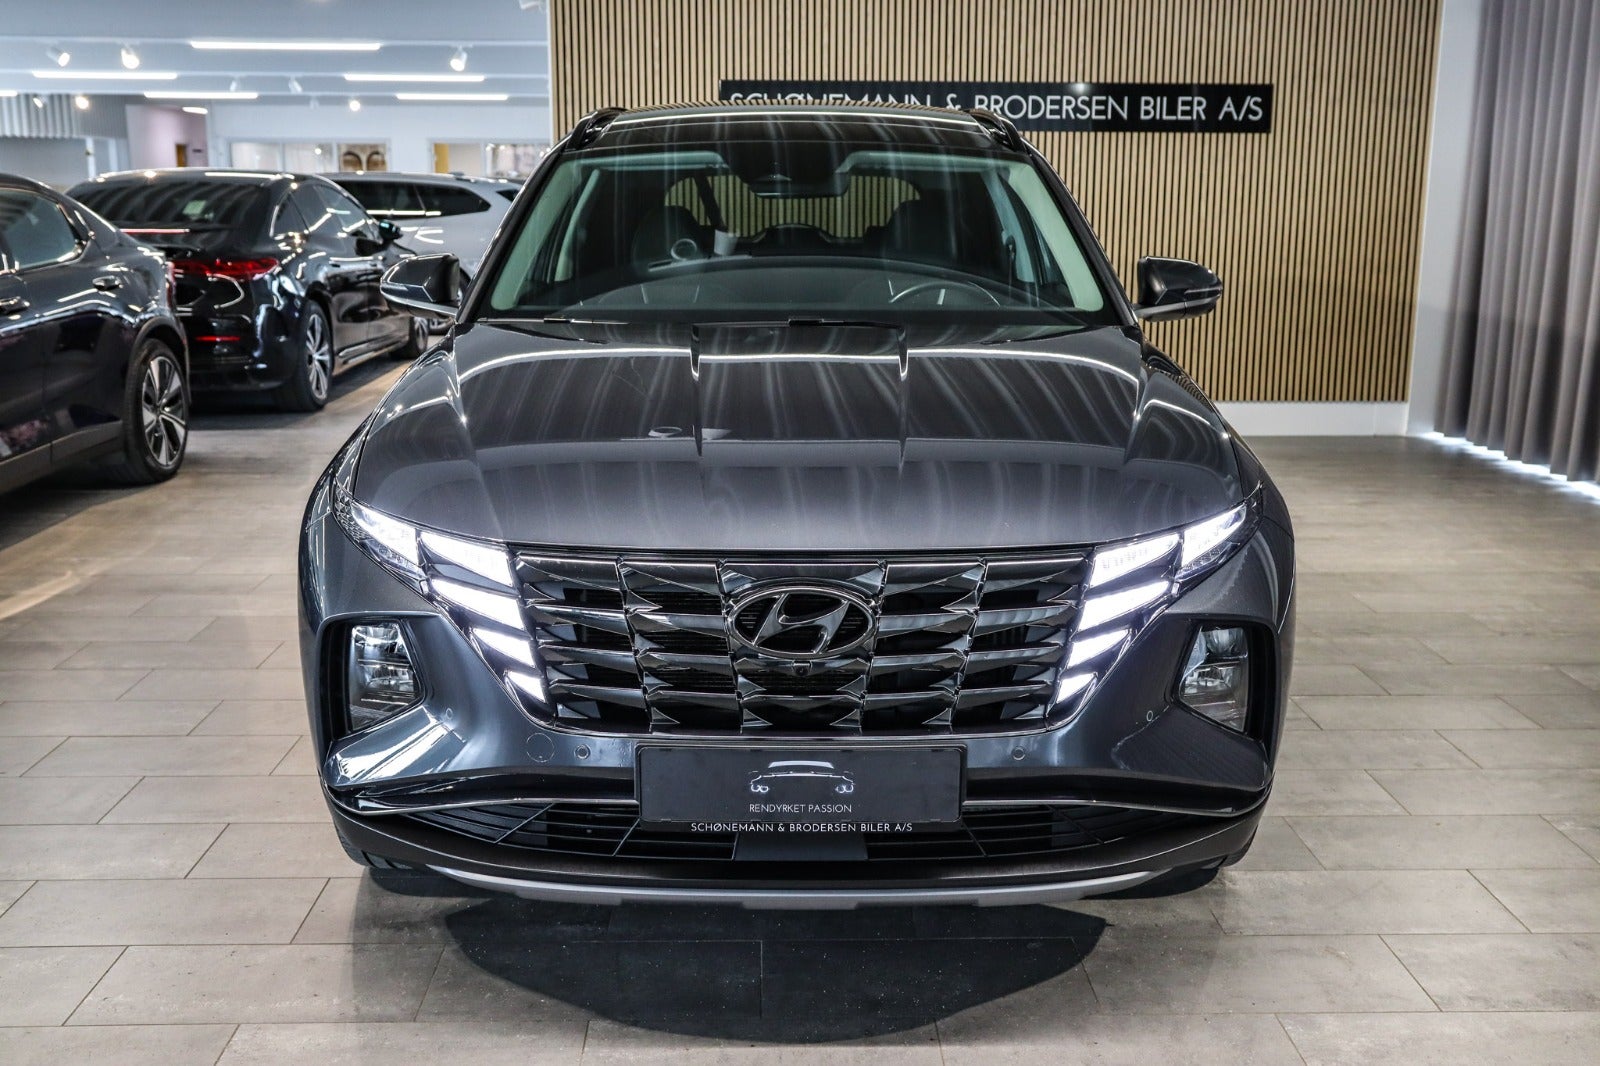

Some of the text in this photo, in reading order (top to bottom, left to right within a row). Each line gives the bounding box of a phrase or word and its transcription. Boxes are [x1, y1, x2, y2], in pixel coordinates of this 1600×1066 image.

[945, 93, 962, 111] &
[975, 94, 1128, 120] BRODERSEN
[1140, 95, 1207, 121] BILER
[1218, 95, 1263, 121] A/S
[749, 803, 852, 813] RENDYRKET PASSION
[690, 822, 913, 832] SCHØNEMANN & BRODERSEN BILER A/S
